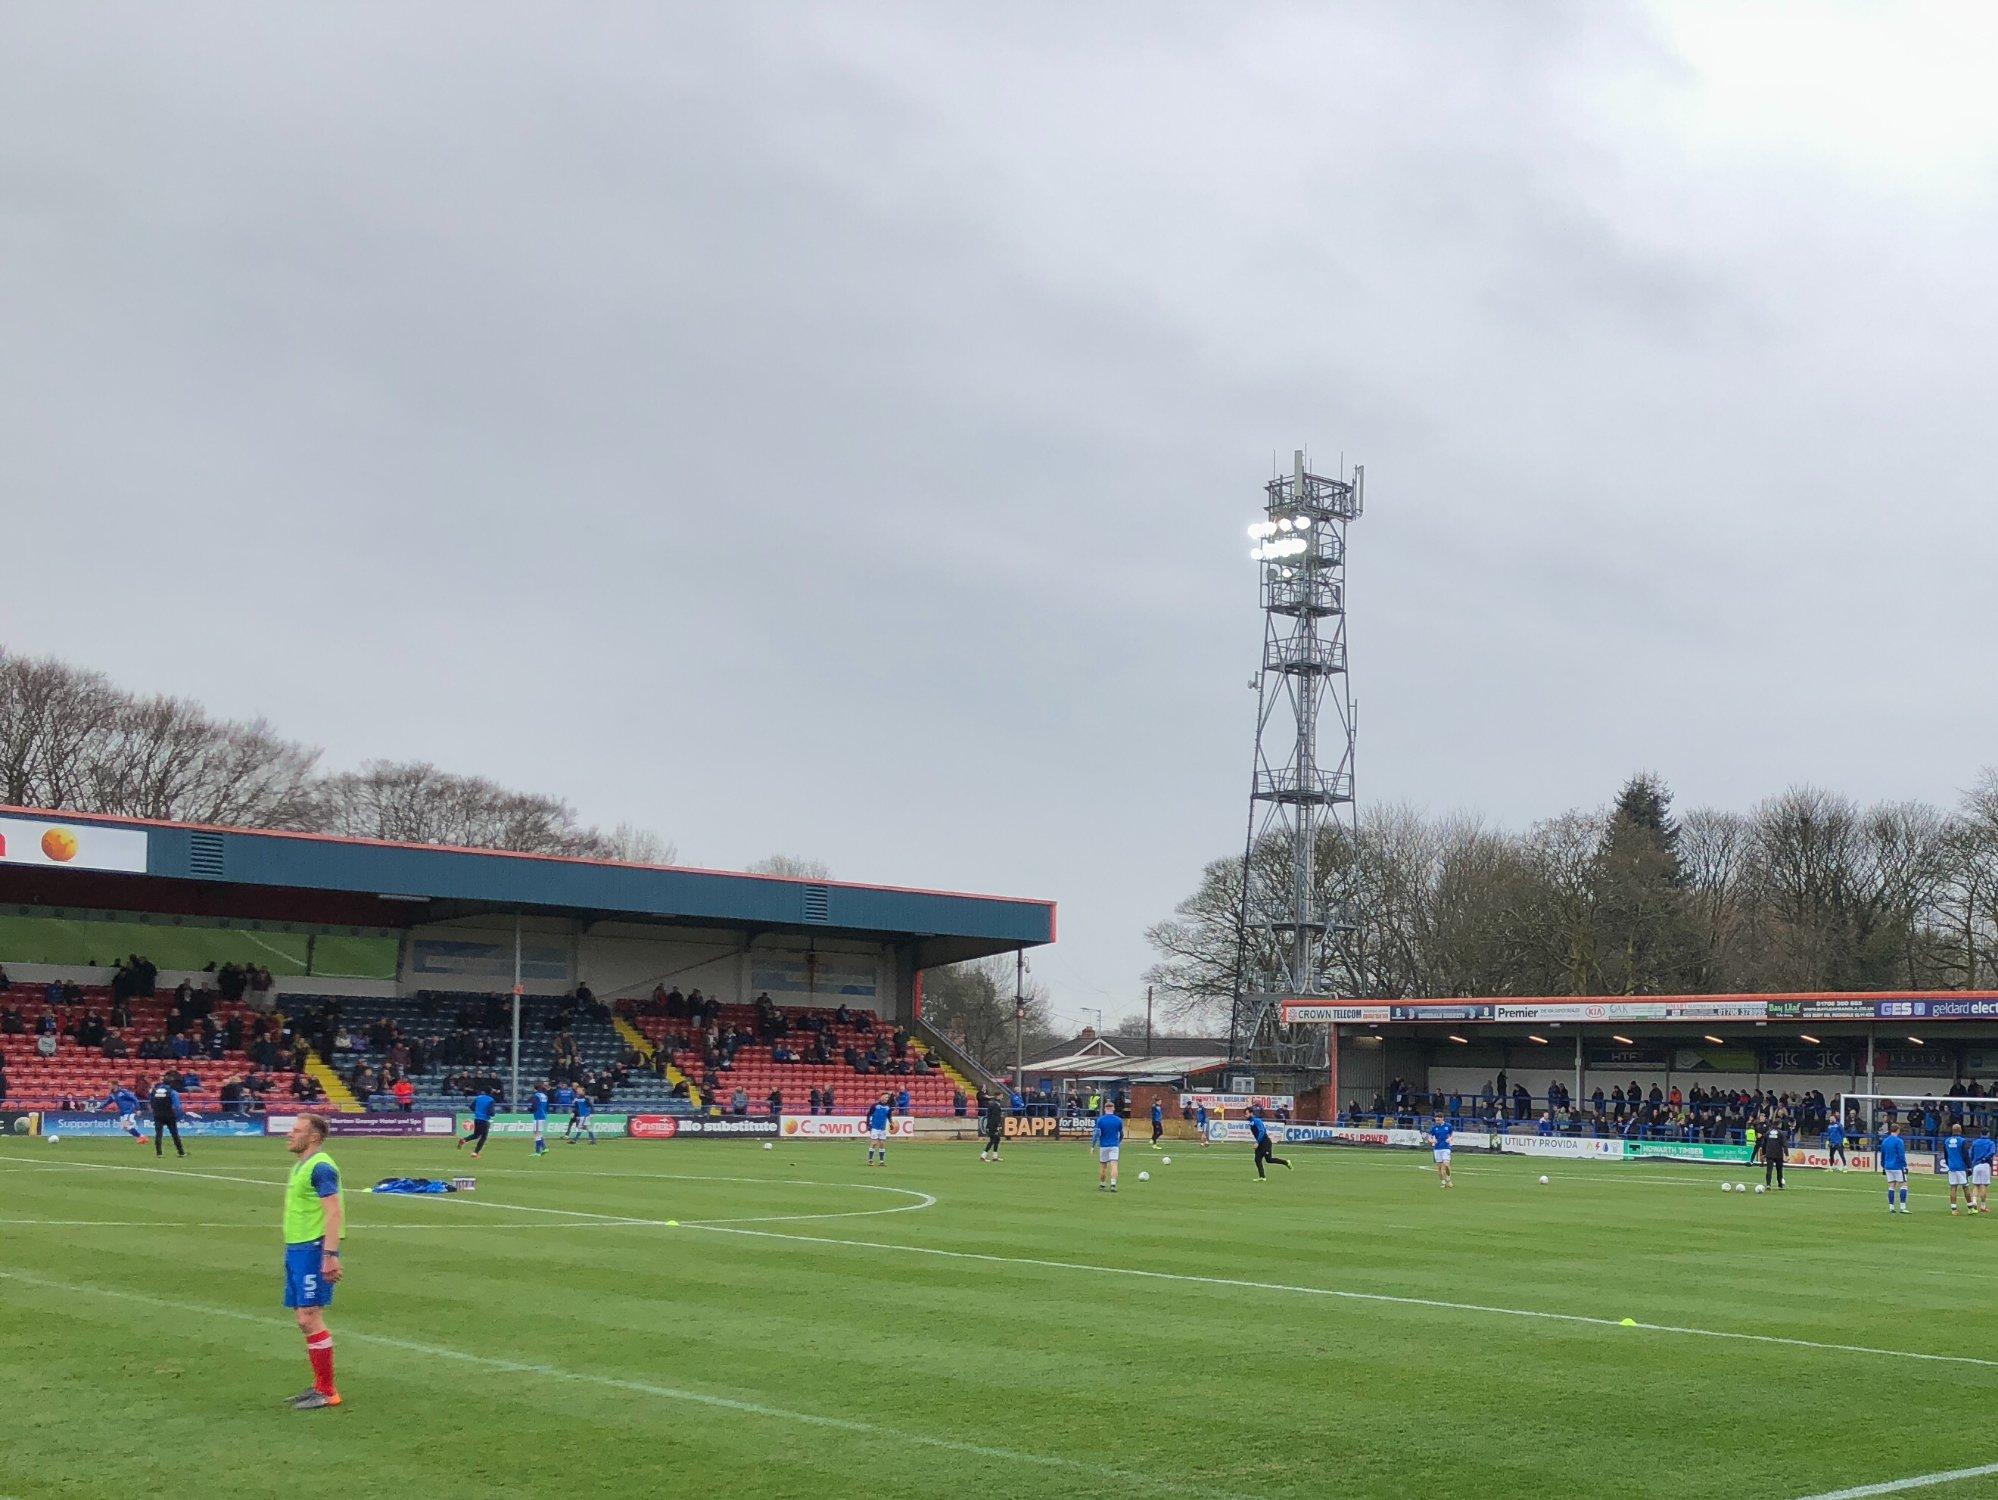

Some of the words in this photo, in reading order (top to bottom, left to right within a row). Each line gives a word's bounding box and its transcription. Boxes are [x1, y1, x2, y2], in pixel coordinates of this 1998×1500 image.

[1298, 1010, 1332, 1019] CROWN
[1333, 1009, 1362, 1019] TELECOM
[1498, 1007, 1539, 1018] Premier
[1881, 1003, 1912, 1015] GES
[1932, 1002, 1969, 1016] geldard
[58, 1119, 106, 1130] Supported
[677, 1121, 701, 1131] No
[703, 1120, 778, 1132] substitute
[1004, 1117, 1057, 1136] BAPP
[1059, 1118, 1072, 1127] for
[1073, 1117, 1096, 1127] Bolts
[1286, 1128, 1333, 1141] CROWN
[1360, 1133, 1389, 1144] POWER
[1505, 1137, 1537, 1148] UTILITY
[1539, 1138, 1578, 1149] PROVIDA
[1852, 1156, 1870, 1168] Oil
[303, 1274, 317, 1291] 5
